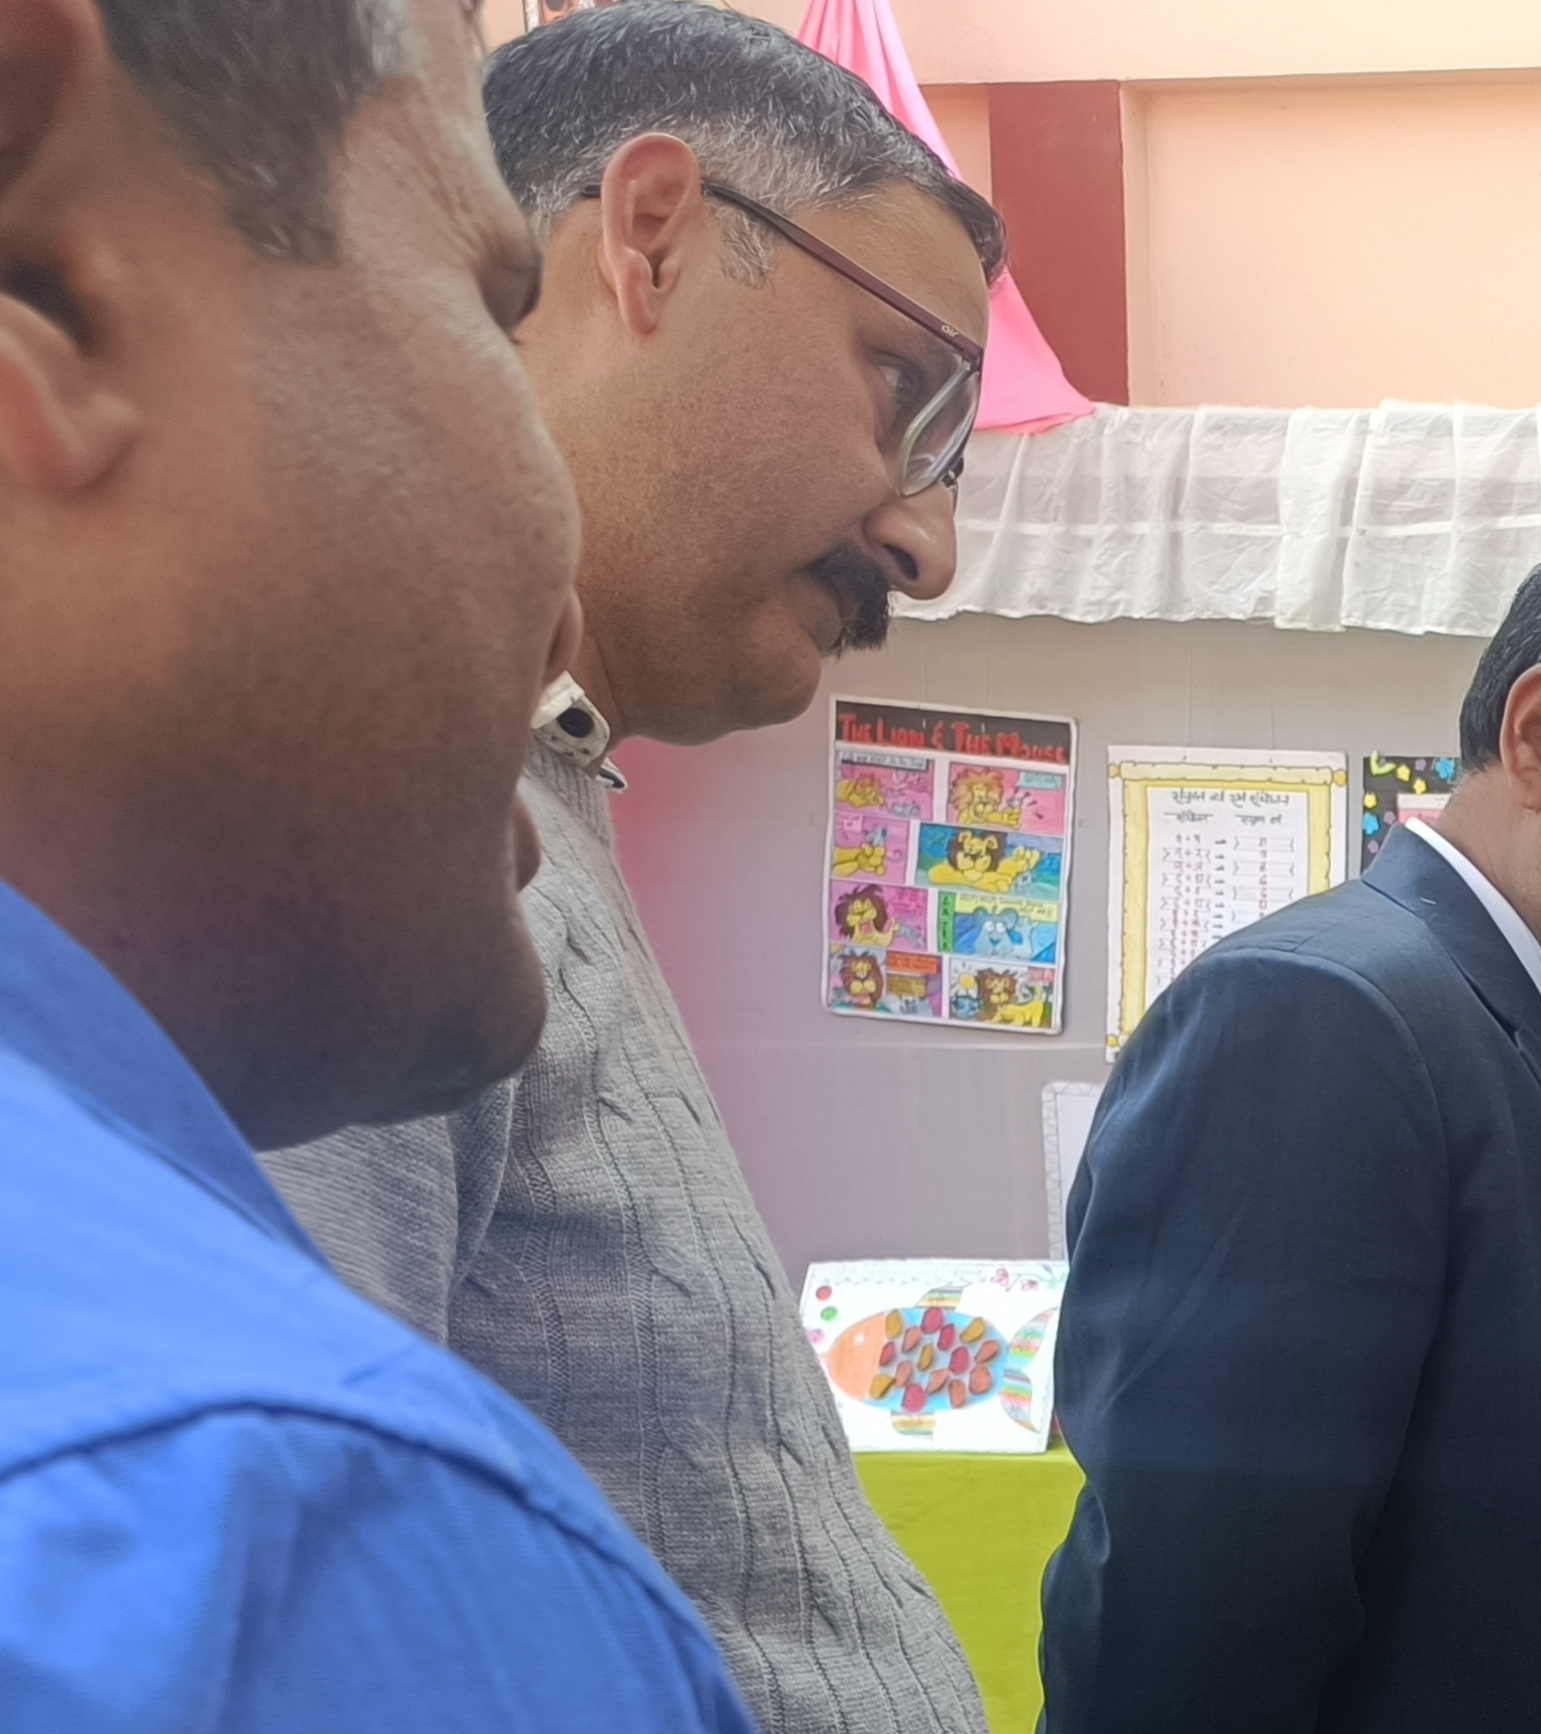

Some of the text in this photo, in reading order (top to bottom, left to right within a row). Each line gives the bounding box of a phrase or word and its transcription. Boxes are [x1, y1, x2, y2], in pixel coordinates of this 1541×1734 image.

[838, 713, 872, 743] THE
[951, 722, 990, 754] THE
[996, 731, 1067, 764] MOUSE
